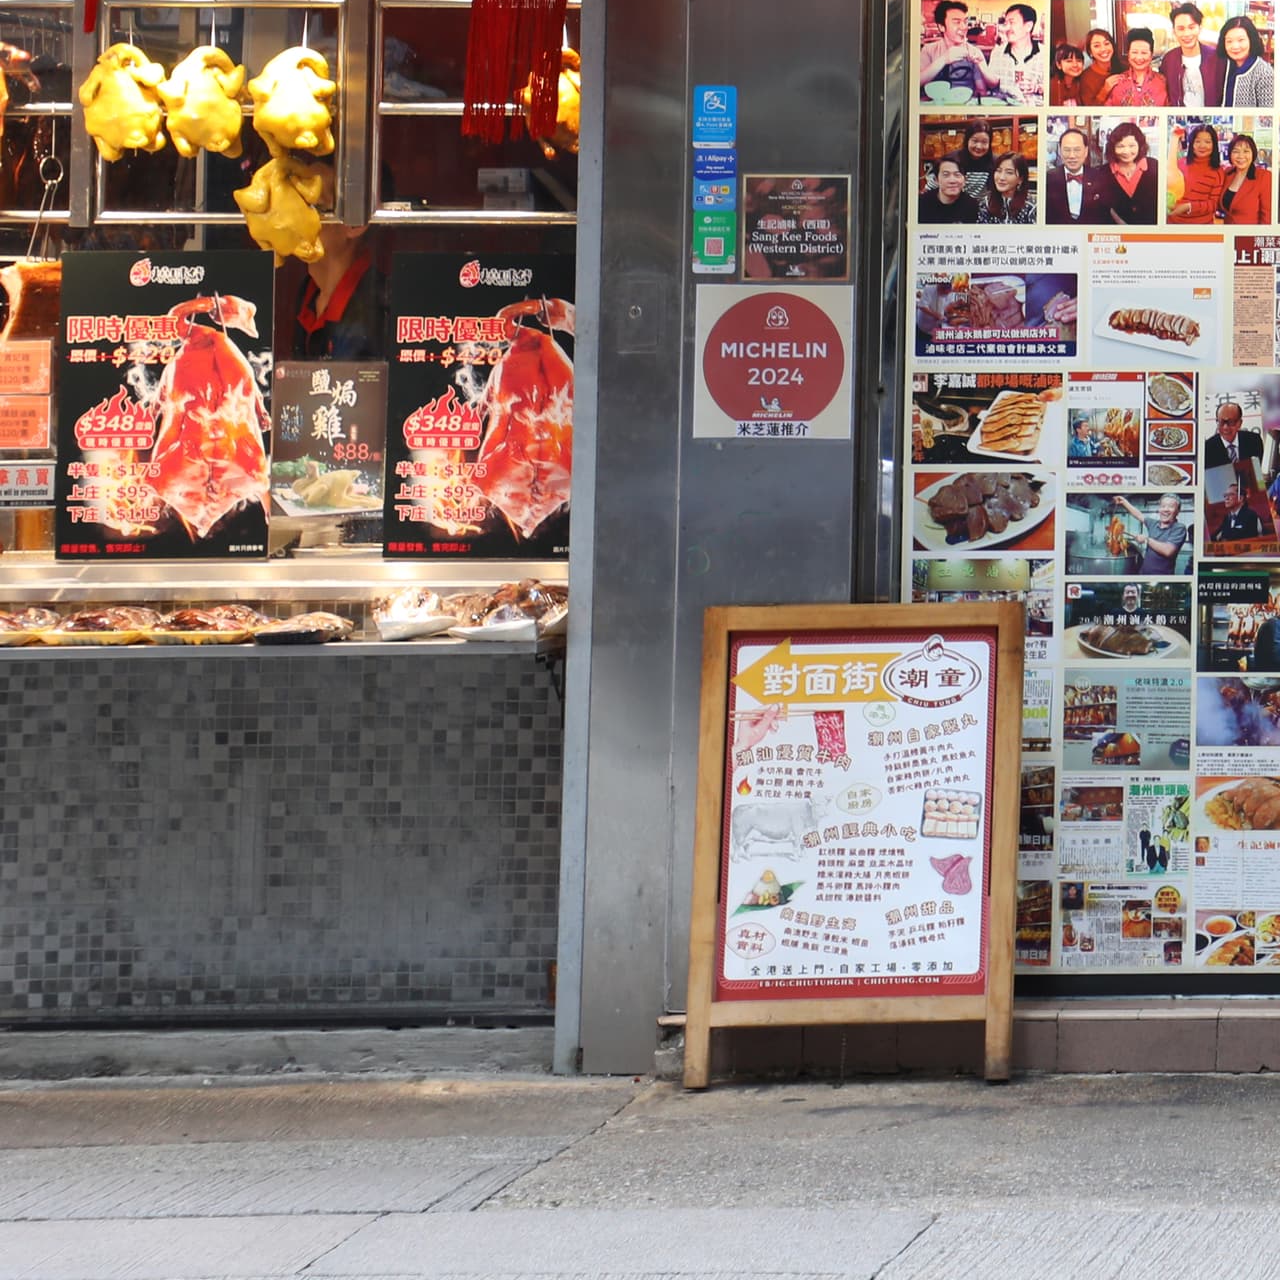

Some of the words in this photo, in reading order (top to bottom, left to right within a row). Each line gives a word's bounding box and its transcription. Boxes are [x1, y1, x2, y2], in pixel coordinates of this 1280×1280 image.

[752, 232, 779, 243] Sang
[782, 232, 802, 241] Kee
[805, 232, 838, 241] Foods
[748, 243, 797, 254] (Western
[800, 243, 844, 254] District)
[66, 315, 179, 344] 限時優惠
[395, 316, 505, 344] 限時優惠
[720, 341, 828, 359] MICHELIN
[747, 368, 804, 386] 2024
[79, 415, 135, 434] $348
[407, 415, 462, 433] $348
[737, 422, 809, 437] 米芝蓮推介
[762, 662, 878, 697] 對面街
[898, 668, 966, 689] 潮童
[907, 697, 930, 708] CHIU
[933, 696, 958, 708] TUNG
[885, 900, 955, 927] 潮州甜品
